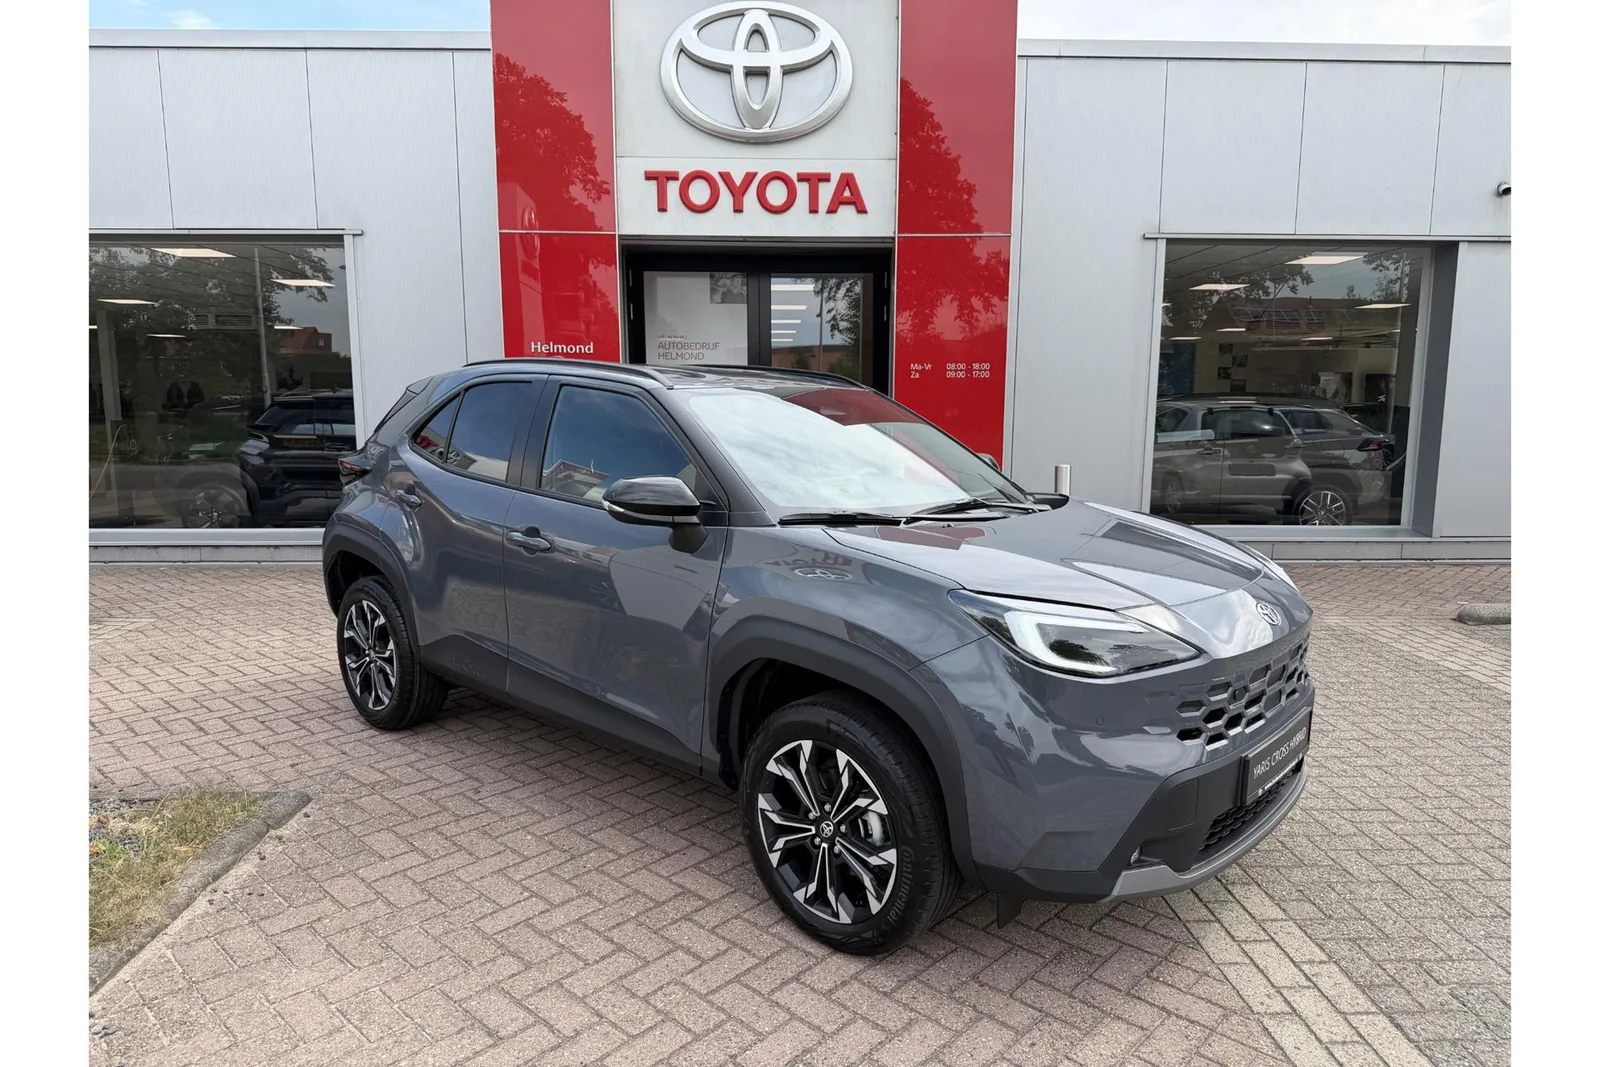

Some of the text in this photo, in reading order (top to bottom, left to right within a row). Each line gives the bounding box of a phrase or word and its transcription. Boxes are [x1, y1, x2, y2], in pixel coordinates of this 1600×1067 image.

[644, 169, 868, 215] TOYOTA
[530, 341, 594, 354] Helmond
[657, 341, 720, 351] AUTOBEDRIJF
[657, 352, 705, 361] HELMOND
[1253, 757, 1270, 779] YARIS
[1271, 742, 1290, 766] CROSS
